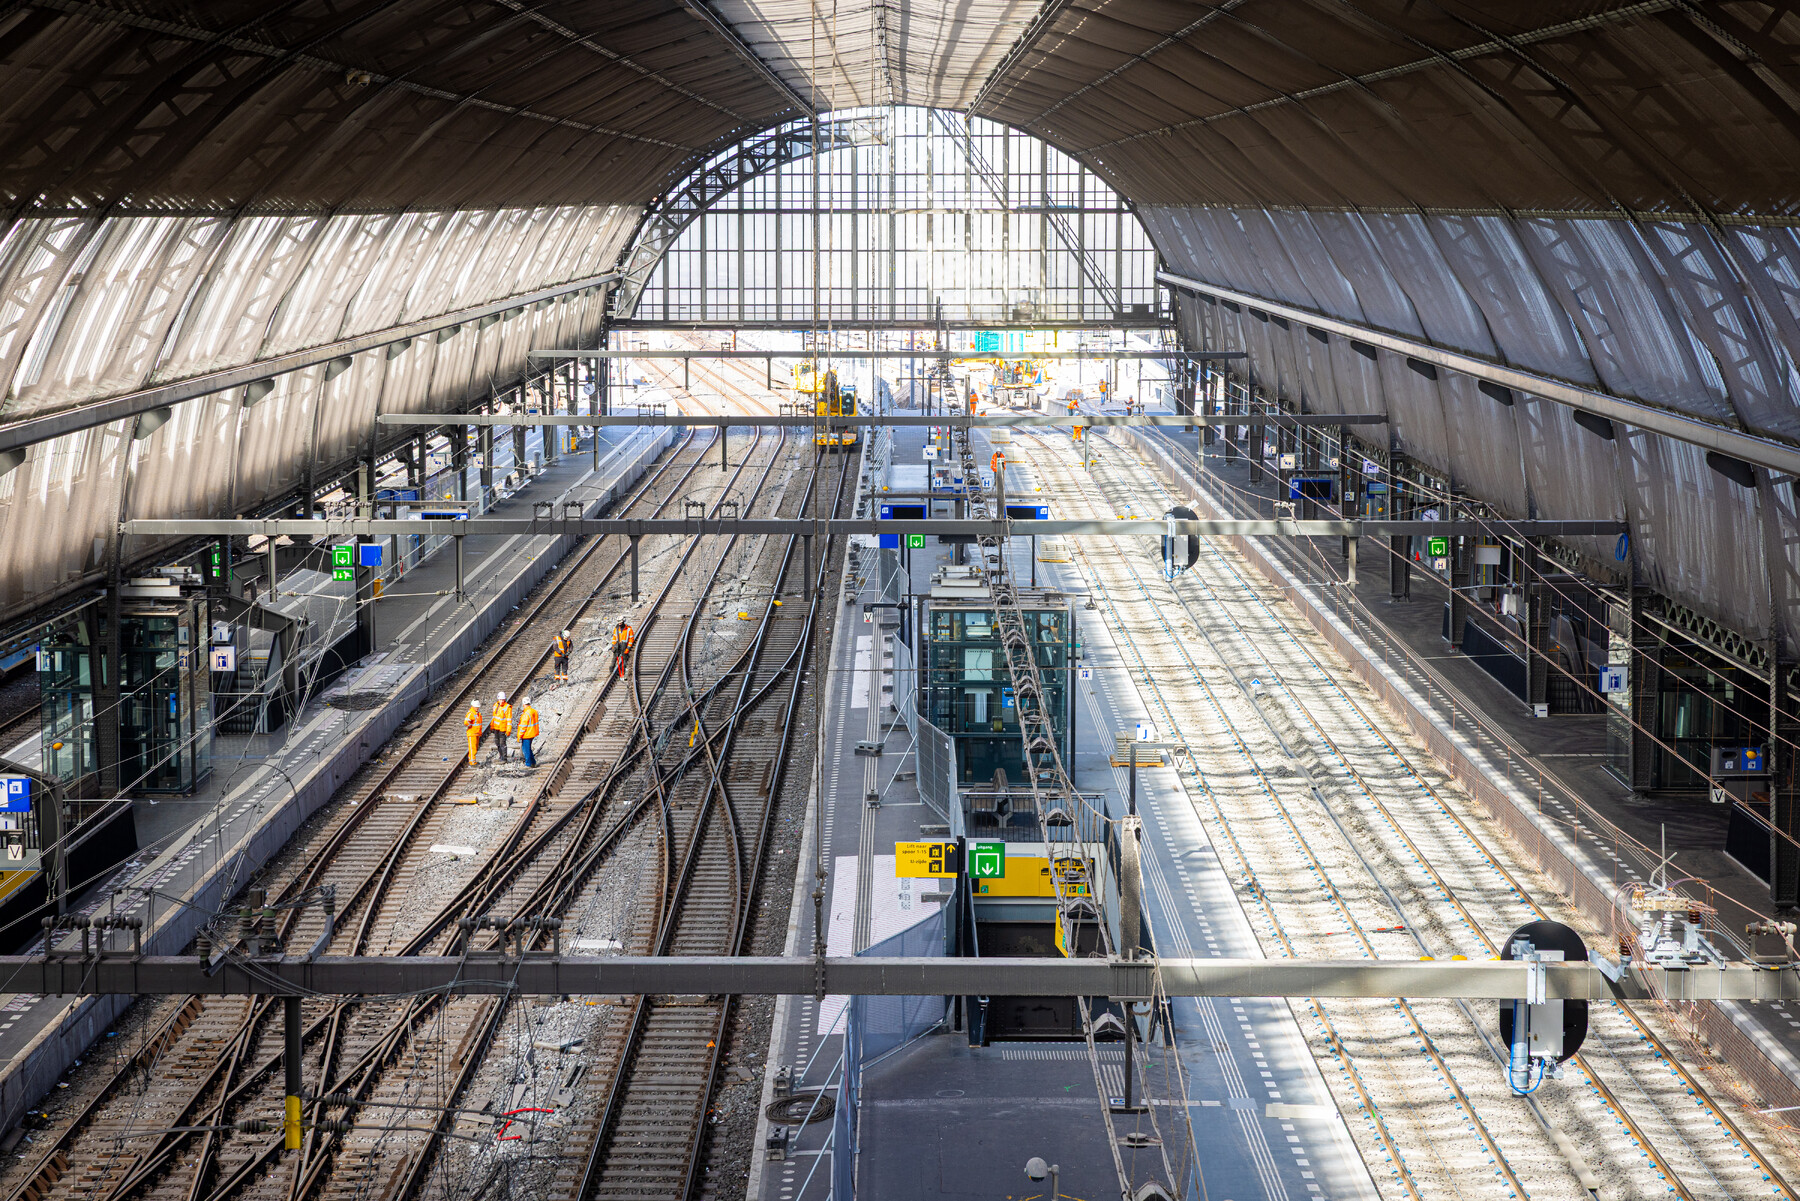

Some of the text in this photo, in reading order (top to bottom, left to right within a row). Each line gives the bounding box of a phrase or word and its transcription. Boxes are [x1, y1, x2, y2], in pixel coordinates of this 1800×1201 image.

[864, 613, 872, 621] V
[1142, 729, 1148, 740] J
[1175, 756, 1186, 769] V
[1713, 789, 1724, 802] V
[9, 845, 21, 859] V
